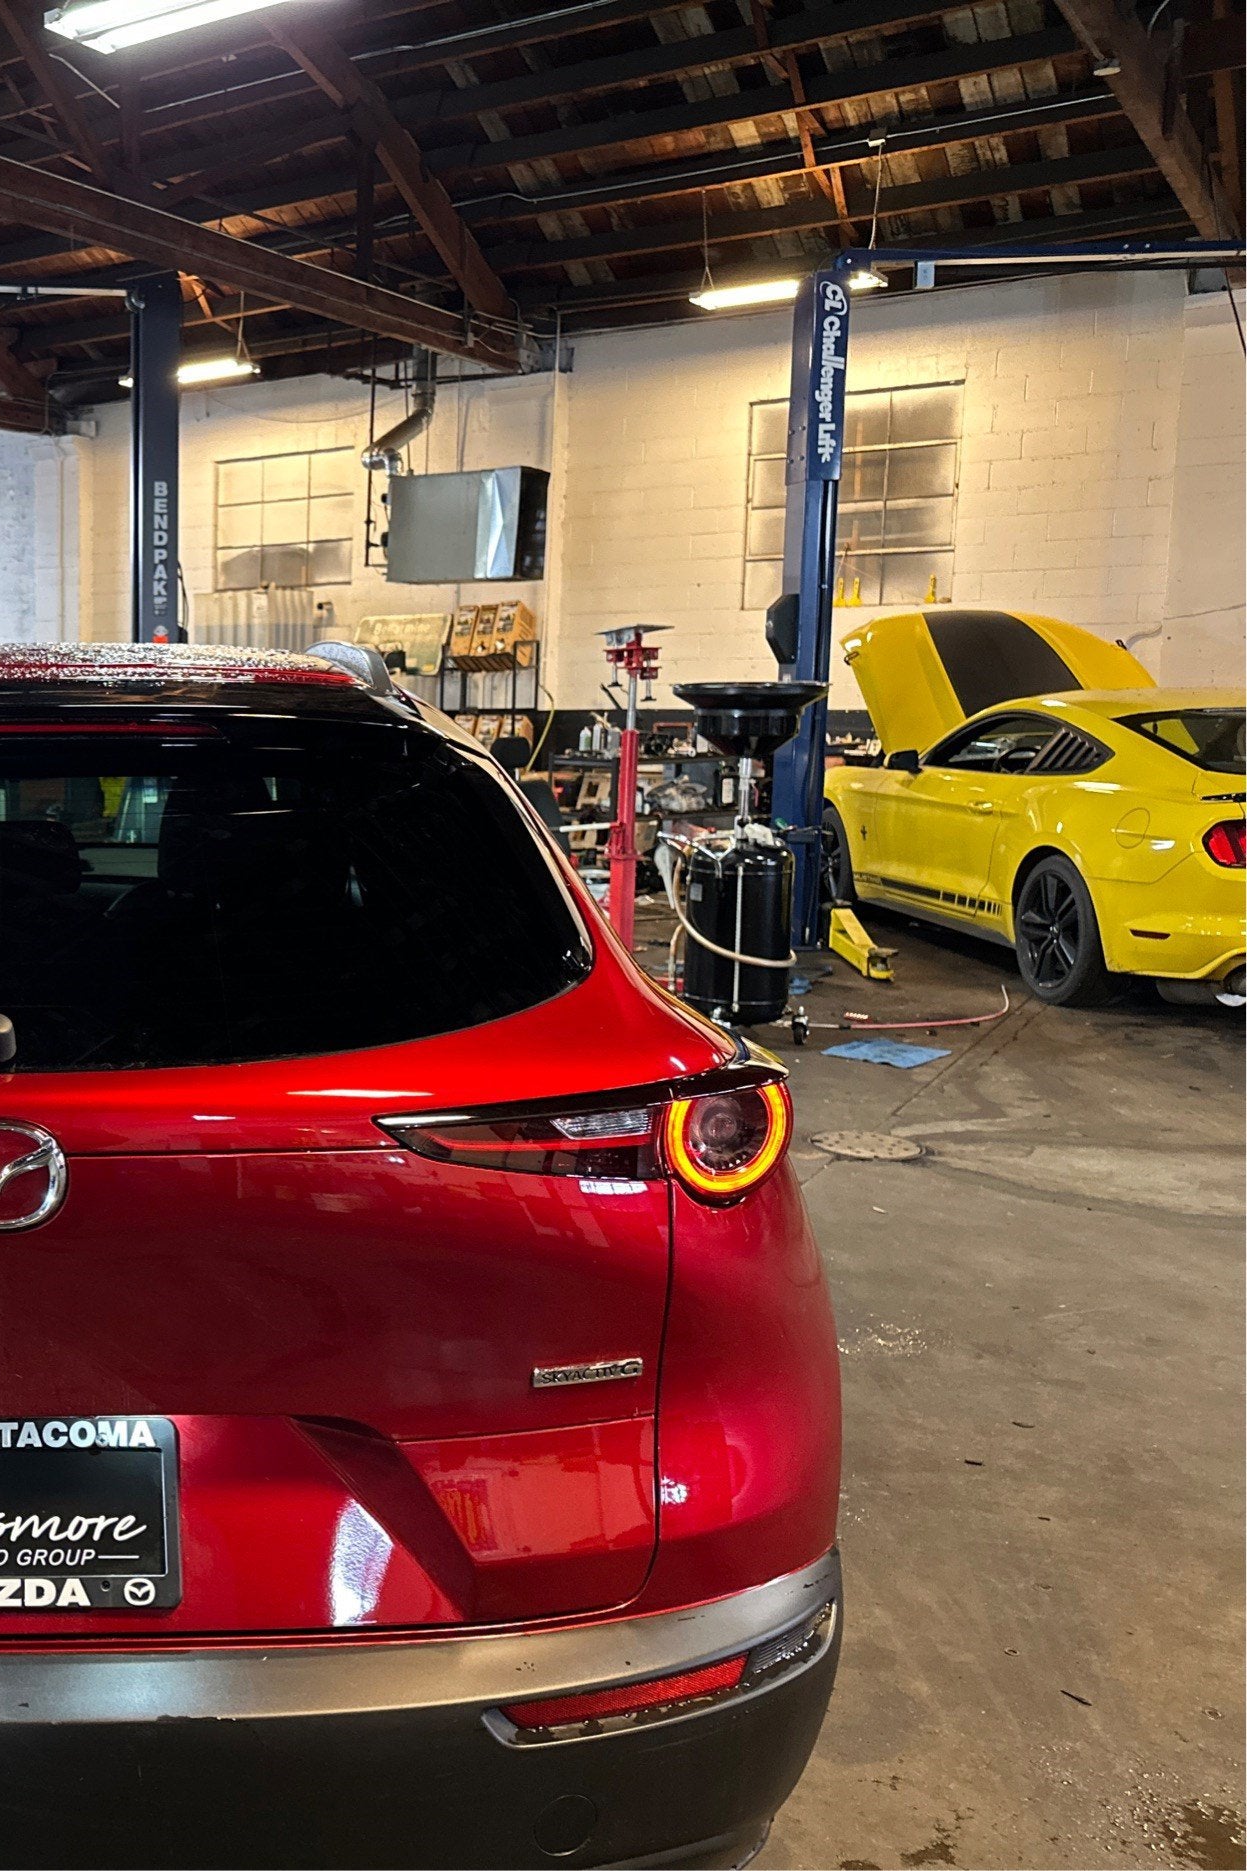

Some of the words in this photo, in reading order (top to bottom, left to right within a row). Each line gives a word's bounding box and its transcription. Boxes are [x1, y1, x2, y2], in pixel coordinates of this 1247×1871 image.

[815, 315, 845, 419] Challenger
[153, 481, 169, 596] BENDPAK
[16, 1548, 97, 1566] GROUP
